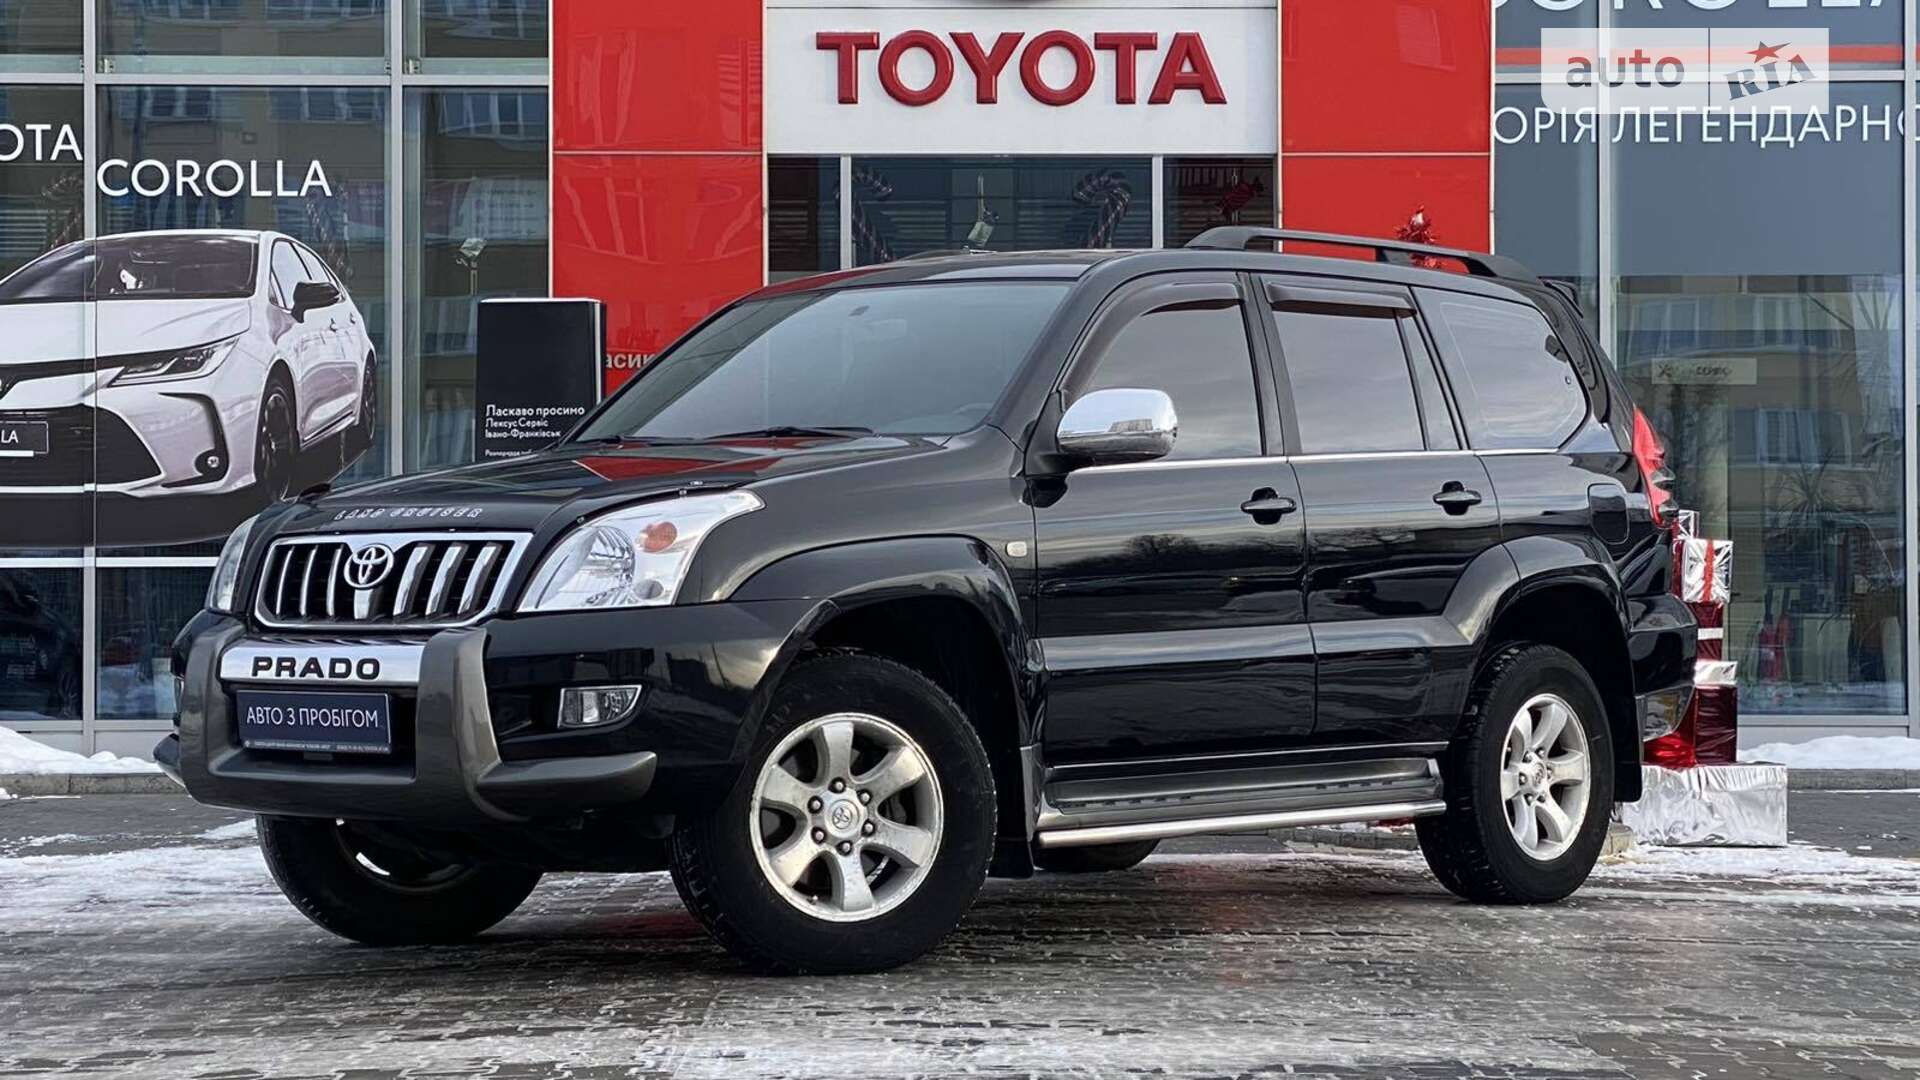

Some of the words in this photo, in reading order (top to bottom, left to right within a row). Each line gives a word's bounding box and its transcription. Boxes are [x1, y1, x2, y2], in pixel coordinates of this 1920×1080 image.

[816, 30, 1228, 107] TOYOTA
[0, 124, 83, 161] OTA
[96, 158, 332, 197] COROLLA
[485, 417, 517, 428] Лексус
[518, 417, 549, 428] Сервіс
[486, 404, 534, 417] Ласкаво
[535, 407, 585, 418] просимо
[485, 428, 561, 439] Івано-Франківськ
[251, 656, 380, 680] PRADO
[246, 705, 283, 725] АВТО
[299, 708, 378, 728] ПРОБІГОМ
